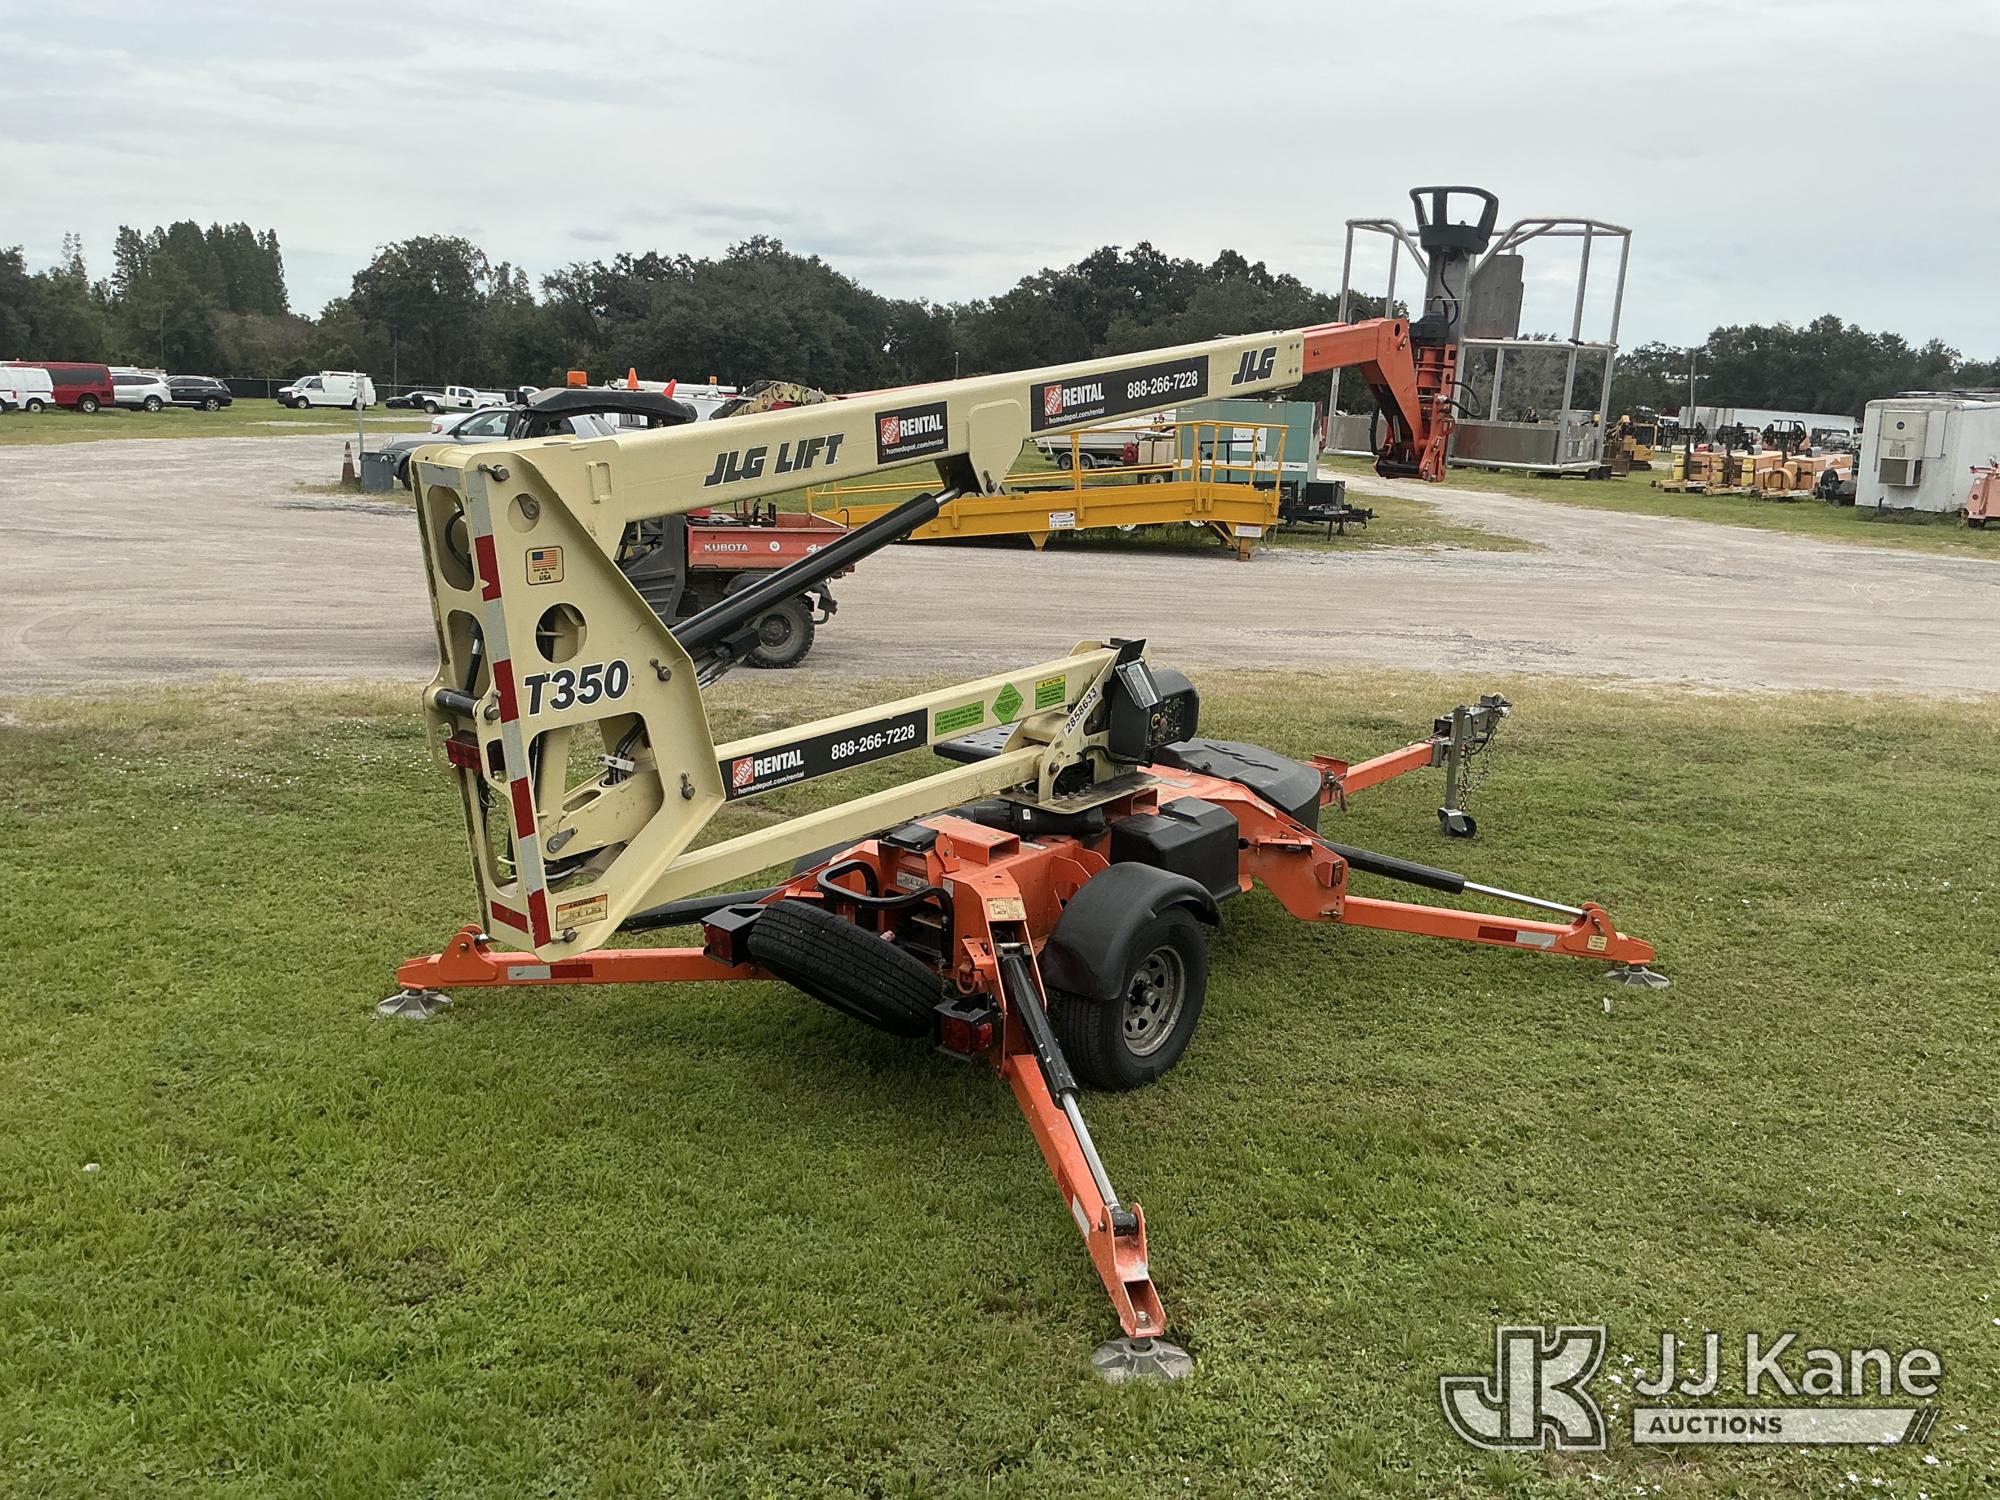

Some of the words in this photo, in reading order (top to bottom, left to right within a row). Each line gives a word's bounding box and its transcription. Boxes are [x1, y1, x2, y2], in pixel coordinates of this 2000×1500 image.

[1230, 347, 1277, 387] JLG
[1063, 383, 1105, 407] RENTAL
[1127, 370, 1198, 399] 888-266-7228
[900, 414, 944, 437] RENTAL
[1049, 407, 1105, 424] homedepot.com/rental
[703, 445, 768, 488] JLG
[773, 432, 844, 475] LIFT
[886, 438, 944, 455] homedepot.com/rental
[704, 543, 749, 552] KUBOTA
[523, 659, 630, 717] T350
[1065, 687, 1097, 734] 2858633
[831, 724, 915, 760] 888-266-7228
[754, 749, 804, 777] RENTAL
[738, 770, 805, 795] homedepot.com/rental
